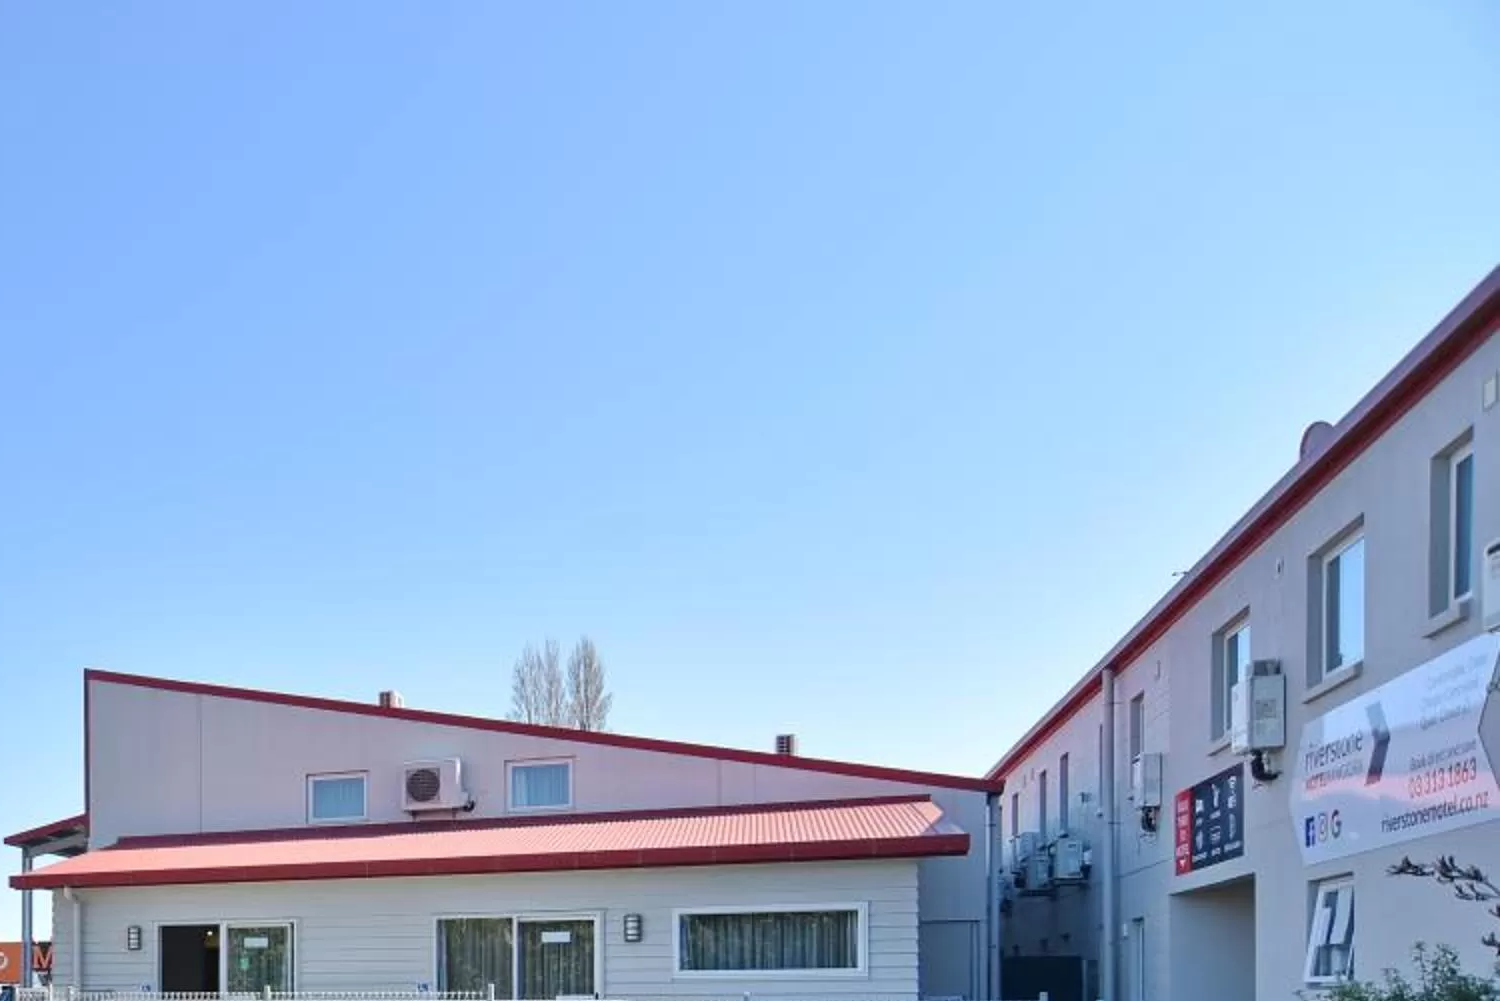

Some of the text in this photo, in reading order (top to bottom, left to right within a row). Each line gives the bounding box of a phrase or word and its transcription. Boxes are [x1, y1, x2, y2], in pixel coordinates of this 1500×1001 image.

[1424, 767, 1445, 795] 313
[1448, 756, 1477, 788] 1863
[1381, 791, 1489, 833] riverstonemotel.co.nz
